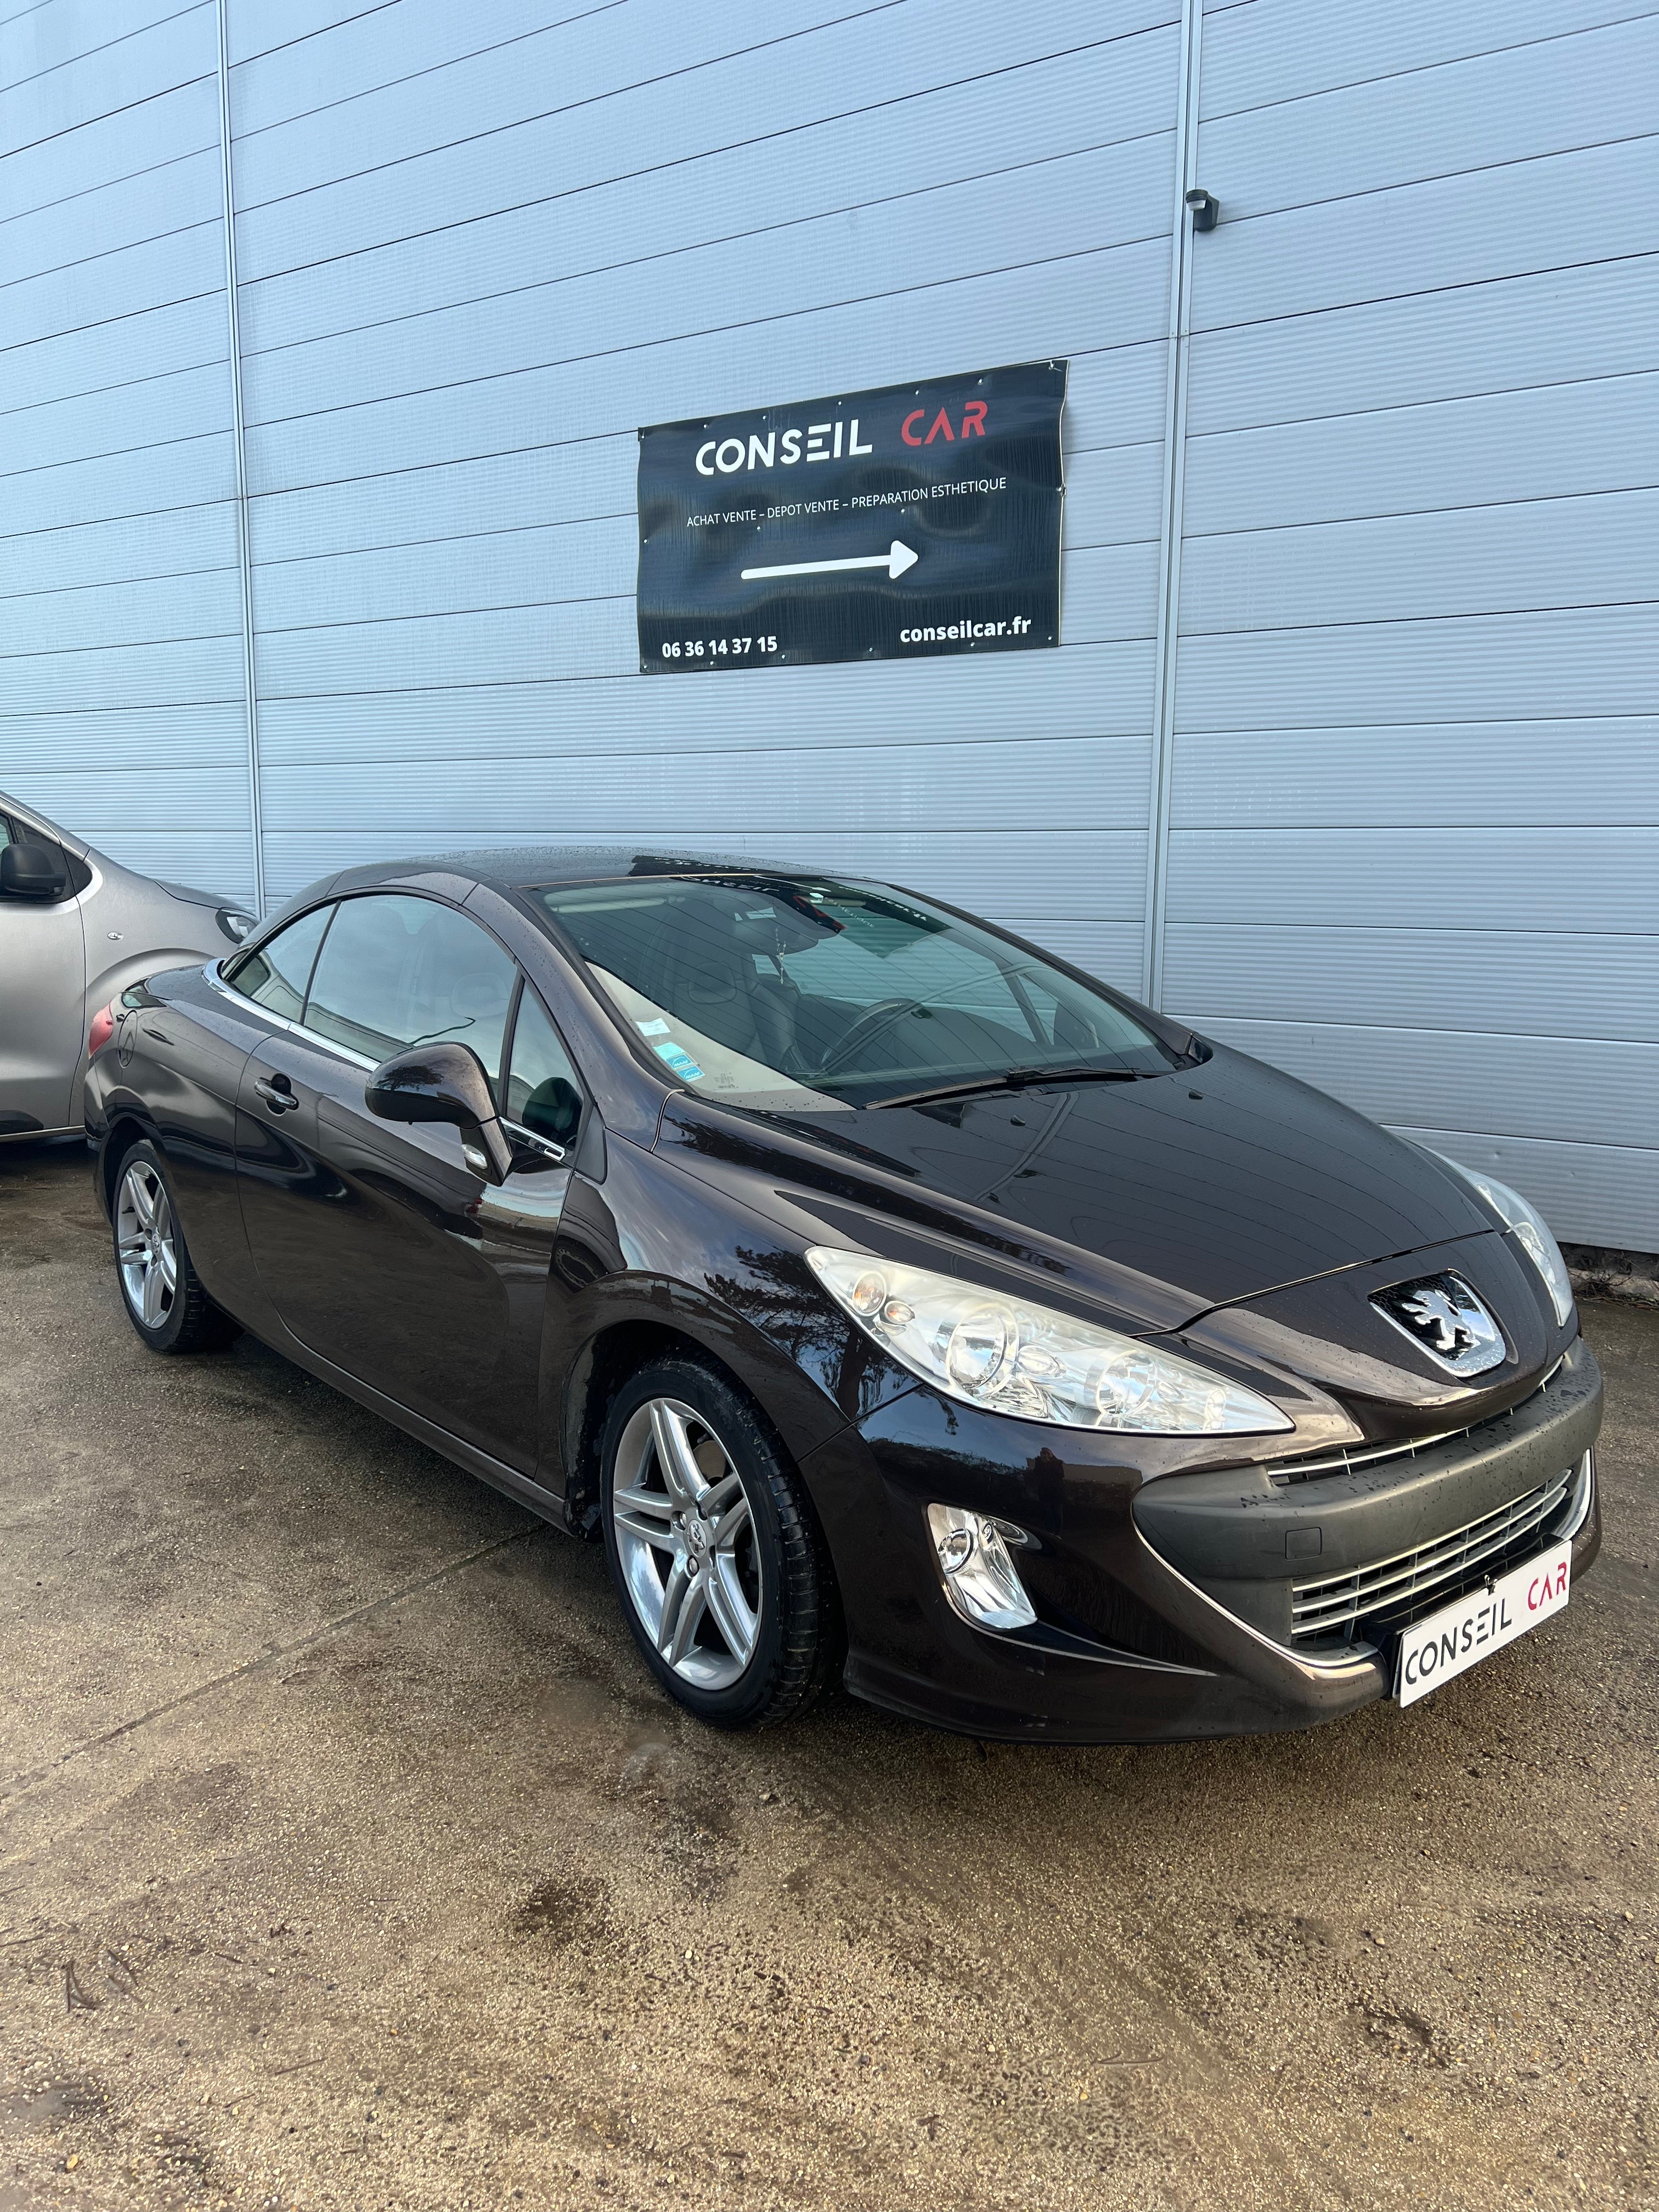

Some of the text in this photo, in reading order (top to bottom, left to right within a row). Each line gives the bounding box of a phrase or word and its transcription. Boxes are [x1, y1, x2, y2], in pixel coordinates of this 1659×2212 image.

[695, 400, 988, 476] CONSEIL CAR
[686, 513, 721, 527] ACHAT
[722, 509, 757, 523] VENTE
[767, 503, 802, 518] DEPOT
[804, 499, 840, 514] VENTE
[851, 487, 929, 509] PREPARATION
[932, 477, 1007, 498] ESTHETIQUE
[662, 635, 778, 658] 06 36 14 37 15
[900, 616, 1032, 643] conseilcar.fr
[1405, 1561, 1567, 1685] CONSEIL CAR
